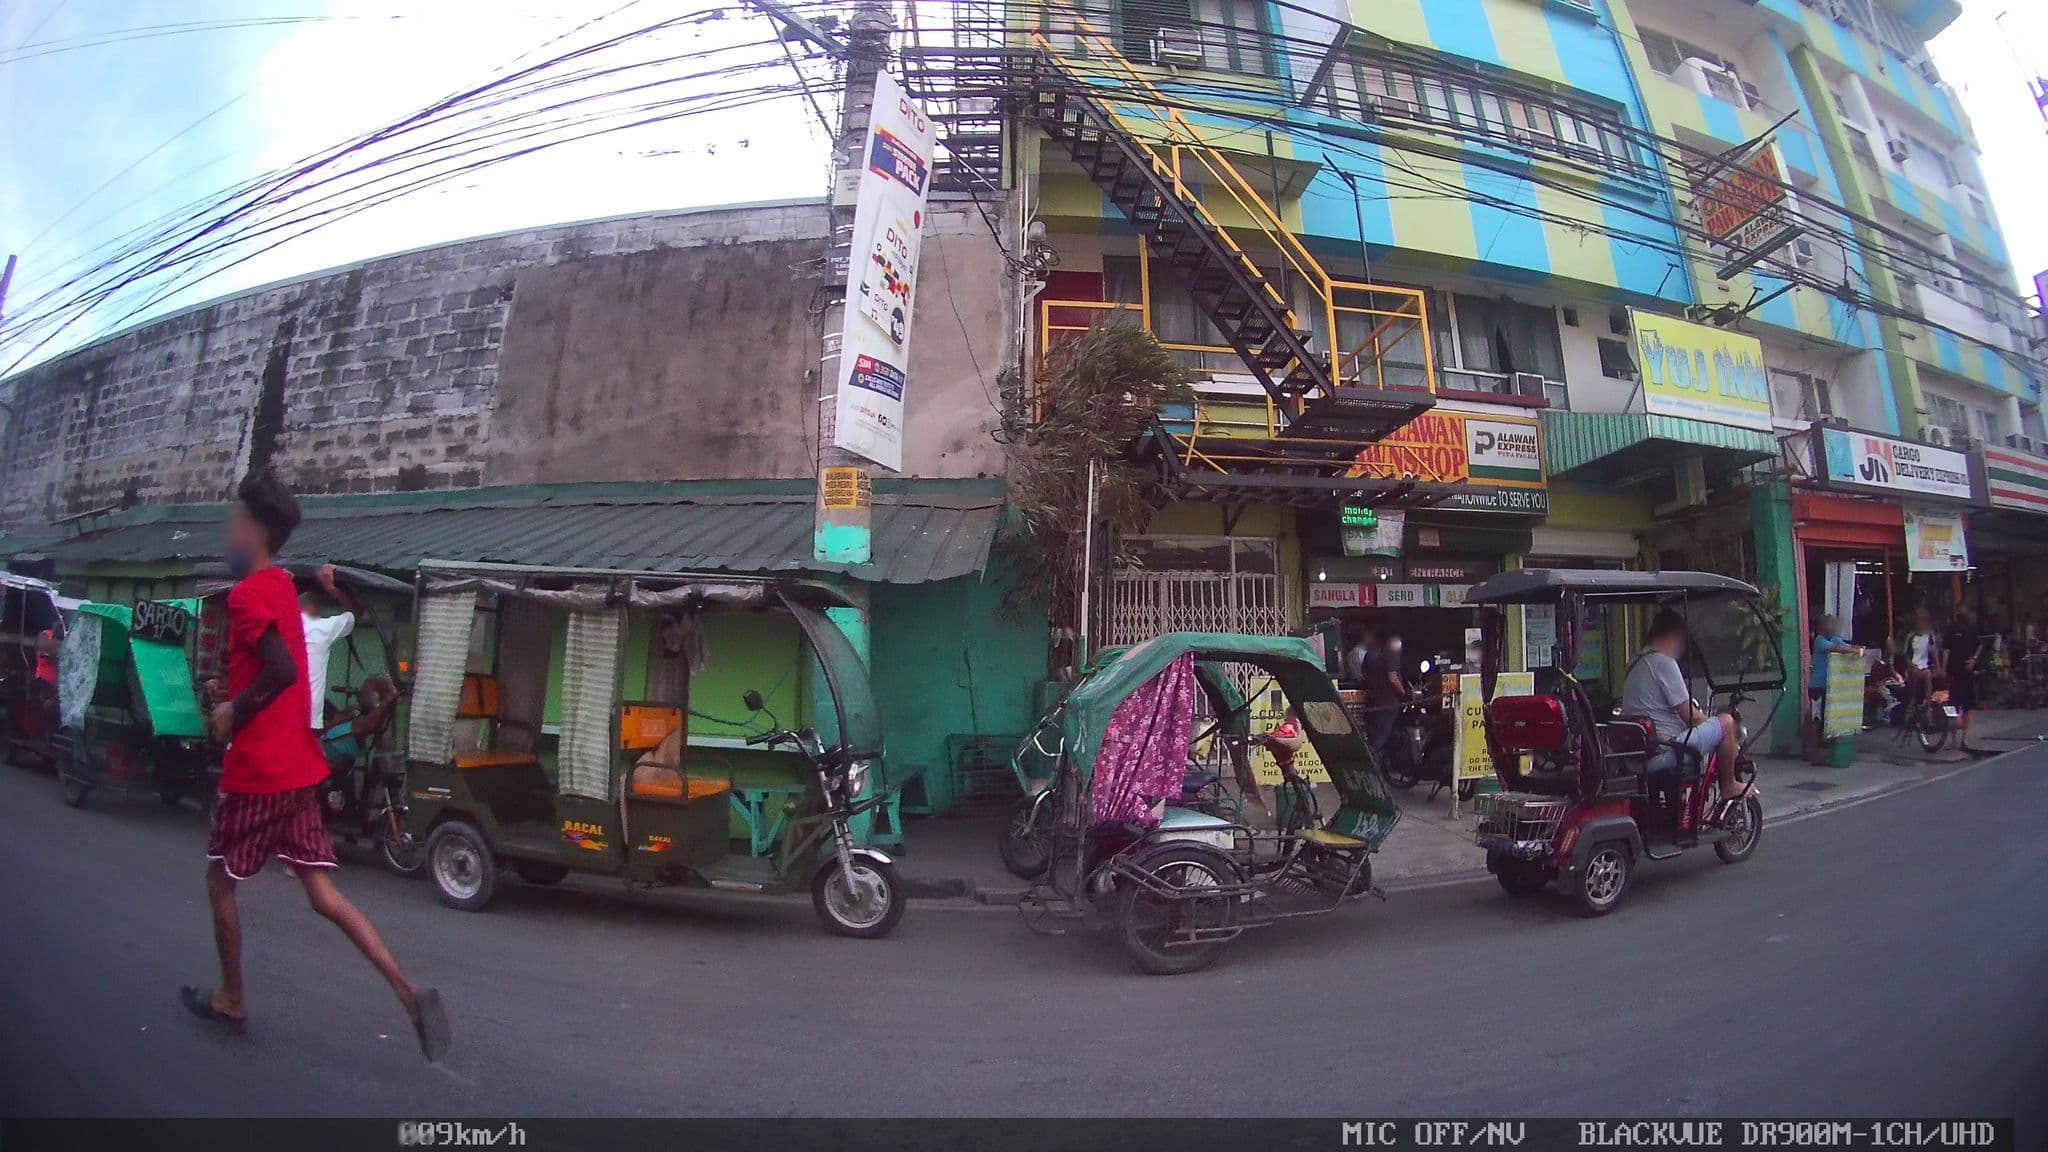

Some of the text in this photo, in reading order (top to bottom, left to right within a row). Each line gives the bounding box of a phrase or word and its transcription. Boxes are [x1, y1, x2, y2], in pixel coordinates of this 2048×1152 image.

[900, 98, 925, 133] DITO
[896, 159, 920, 191] PACK
[887, 228, 908, 259] DITO
[1497, 432, 1536, 445] ALAWAN
[1497, 442, 1537, 453] EXPRESS
[1892, 444, 1921, 462] CARGO
[1351, 442, 1466, 477] AWNSHOP
[1497, 491, 1508, 507] TO
[1509, 492, 1530, 508] SERVE
[1530, 494, 1546, 509] YOU
[1344, 506, 1373, 517] money
[1313, 590, 1356, 601] SANGLA
[1388, 590, 1414, 601] SEND
[1469, 757, 1480, 765] DO
[1262, 766, 1324, 777] THE VEWAY
[1468, 765, 1482, 773] THE
